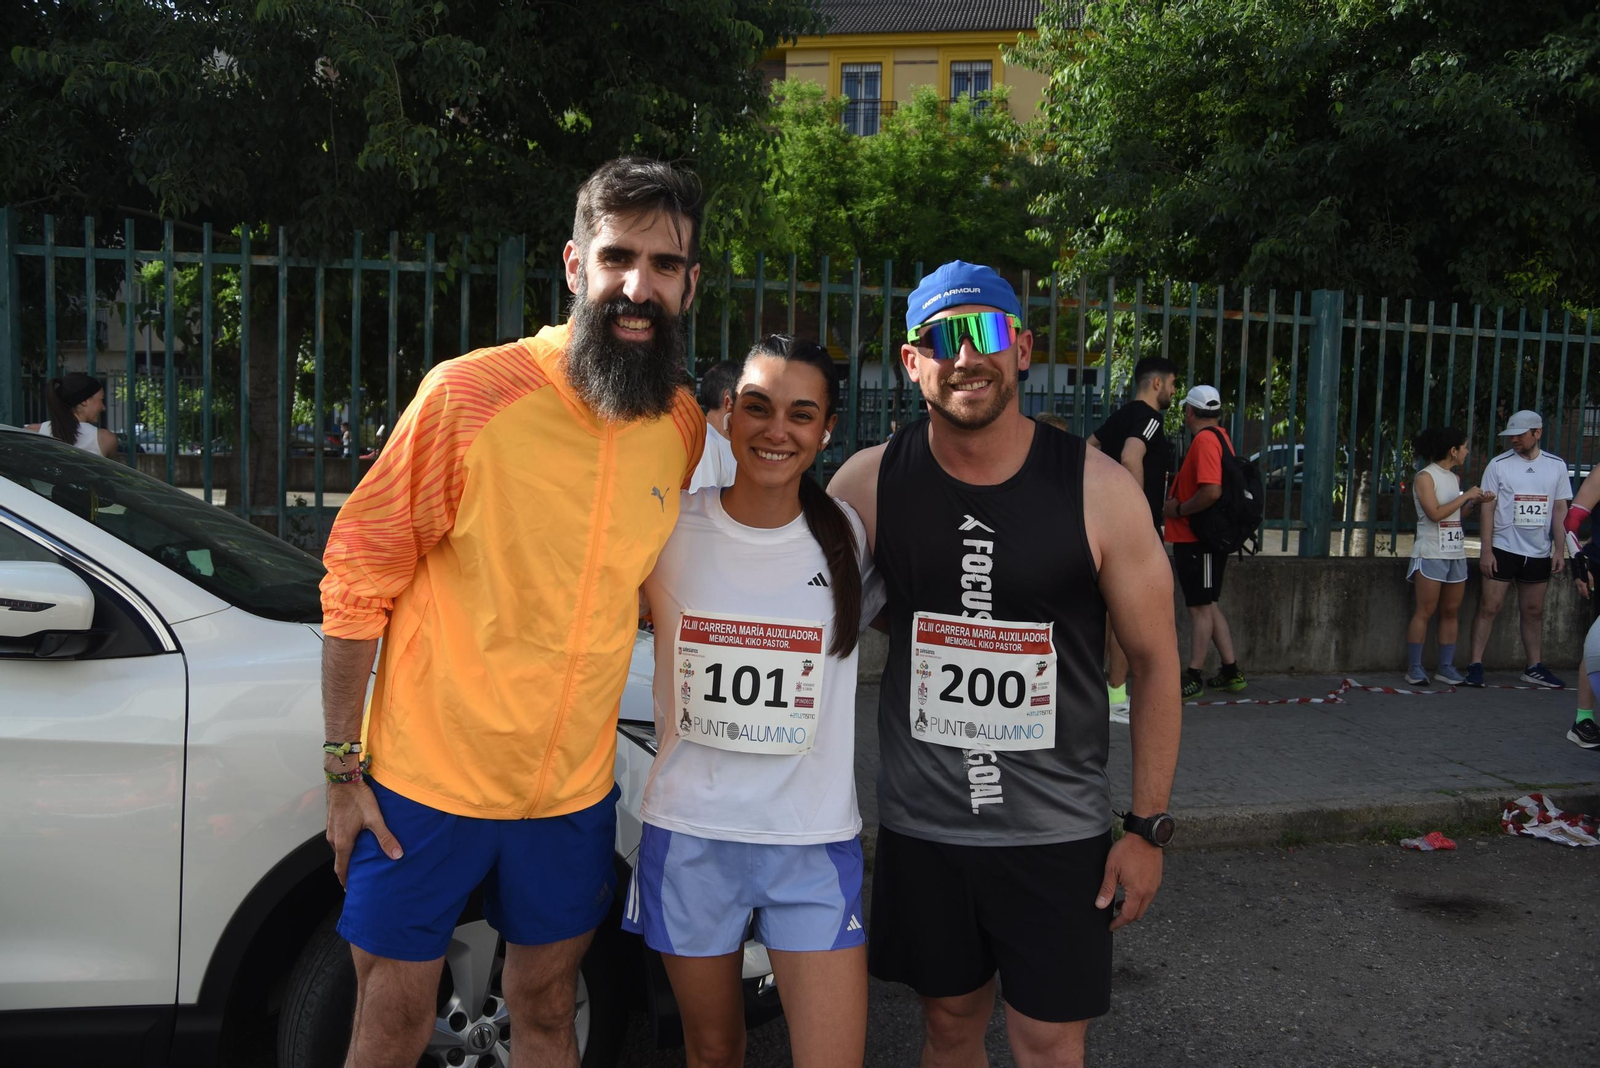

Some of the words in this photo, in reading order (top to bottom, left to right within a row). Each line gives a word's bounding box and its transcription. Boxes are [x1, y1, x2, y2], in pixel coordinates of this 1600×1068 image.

[922, 294, 941, 310] UNDER
[943, 287, 981, 297] ARMOUR
[1519, 505, 1542, 515] 142
[682, 619, 698, 631] XLIII
[698, 621, 737, 635] CARRERA
[738, 624, 764, 637] MARÍA
[765, 627, 821, 642] AUXILIADORA.
[918, 621, 935, 633] XLIII
[935, 623, 971, 637] CARRERA
[972, 627, 997, 639] MARÍA
[708, 634, 743, 645] MEMORIAL
[745, 637, 762, 646] KIKO
[763, 639, 790, 649] PASTOR.
[945, 636, 978, 648] MEMORIAL
[978, 641, 994, 650] KIKO
[995, 642, 1024, 652] PASTOR.
[704, 663, 788, 709] 101
[939, 663, 1026, 709] 200
